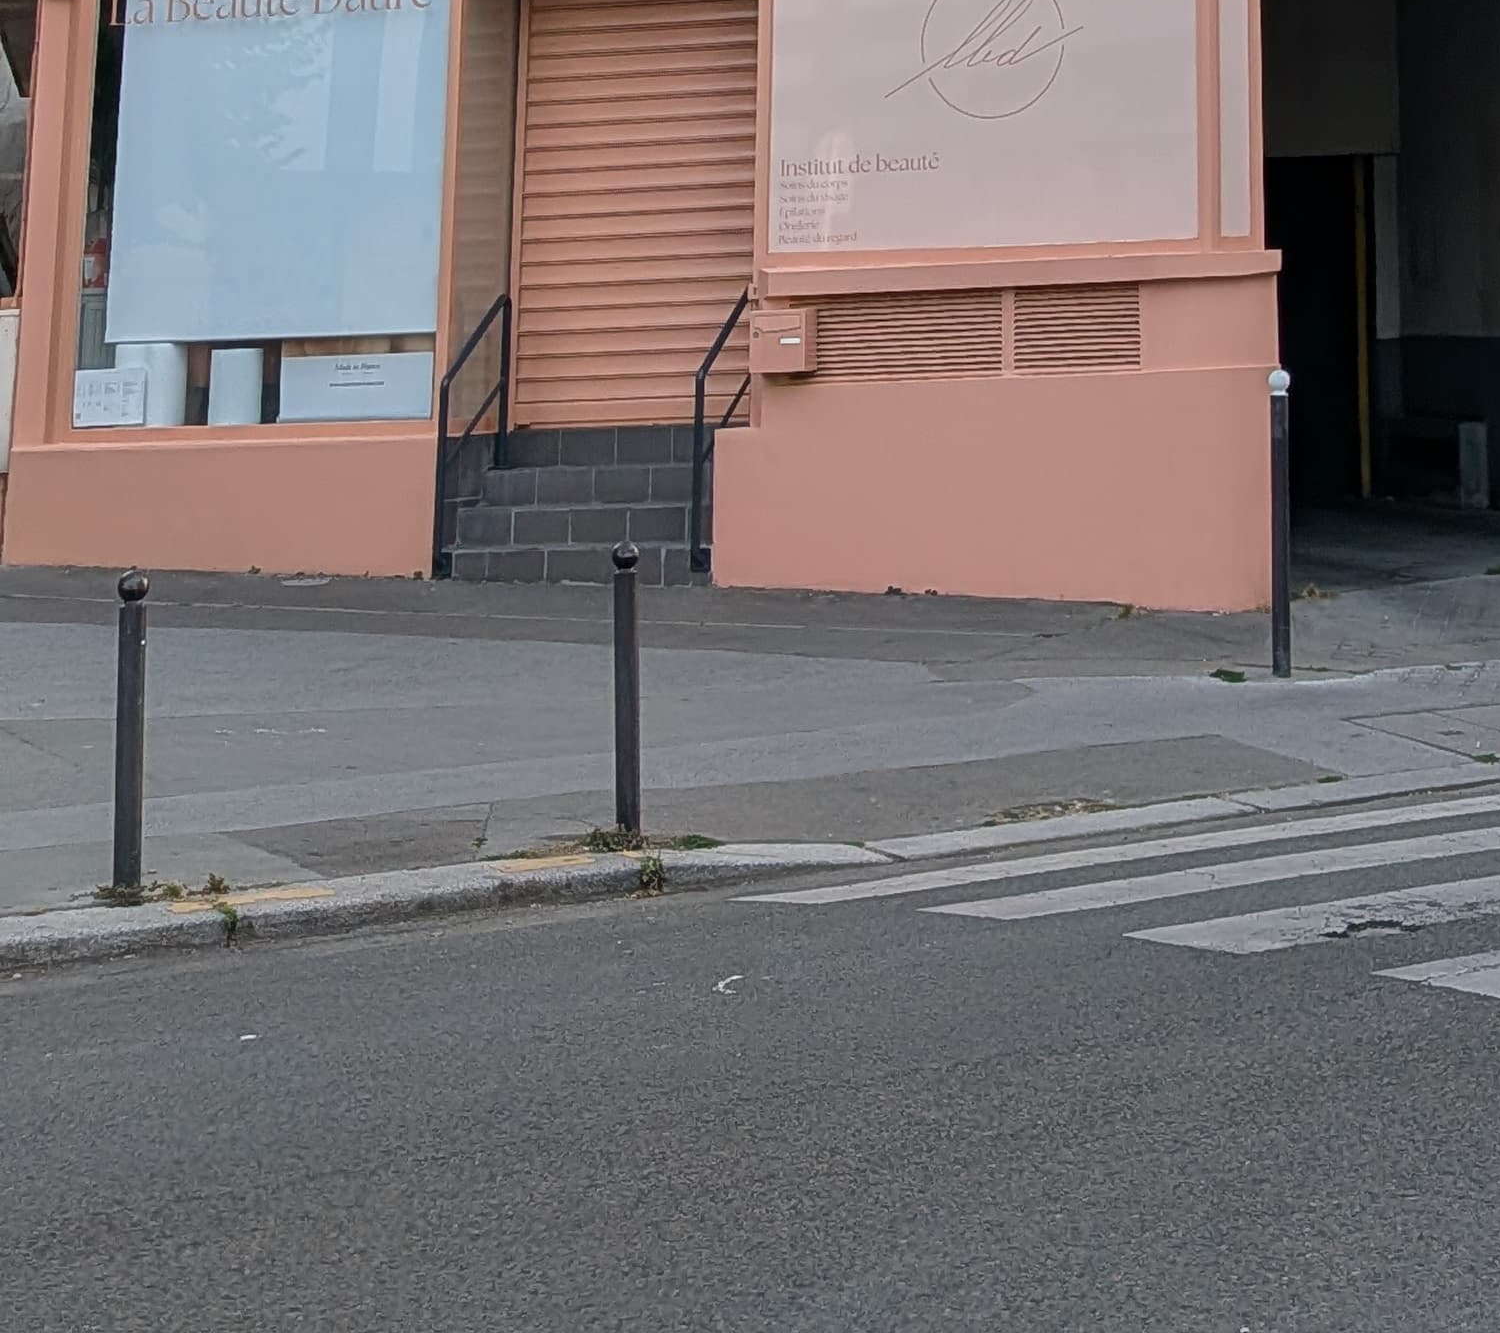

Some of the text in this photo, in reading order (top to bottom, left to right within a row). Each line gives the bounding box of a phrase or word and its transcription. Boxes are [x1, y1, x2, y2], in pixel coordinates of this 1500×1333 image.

[780, 152, 940, 177] Institut de beauté
